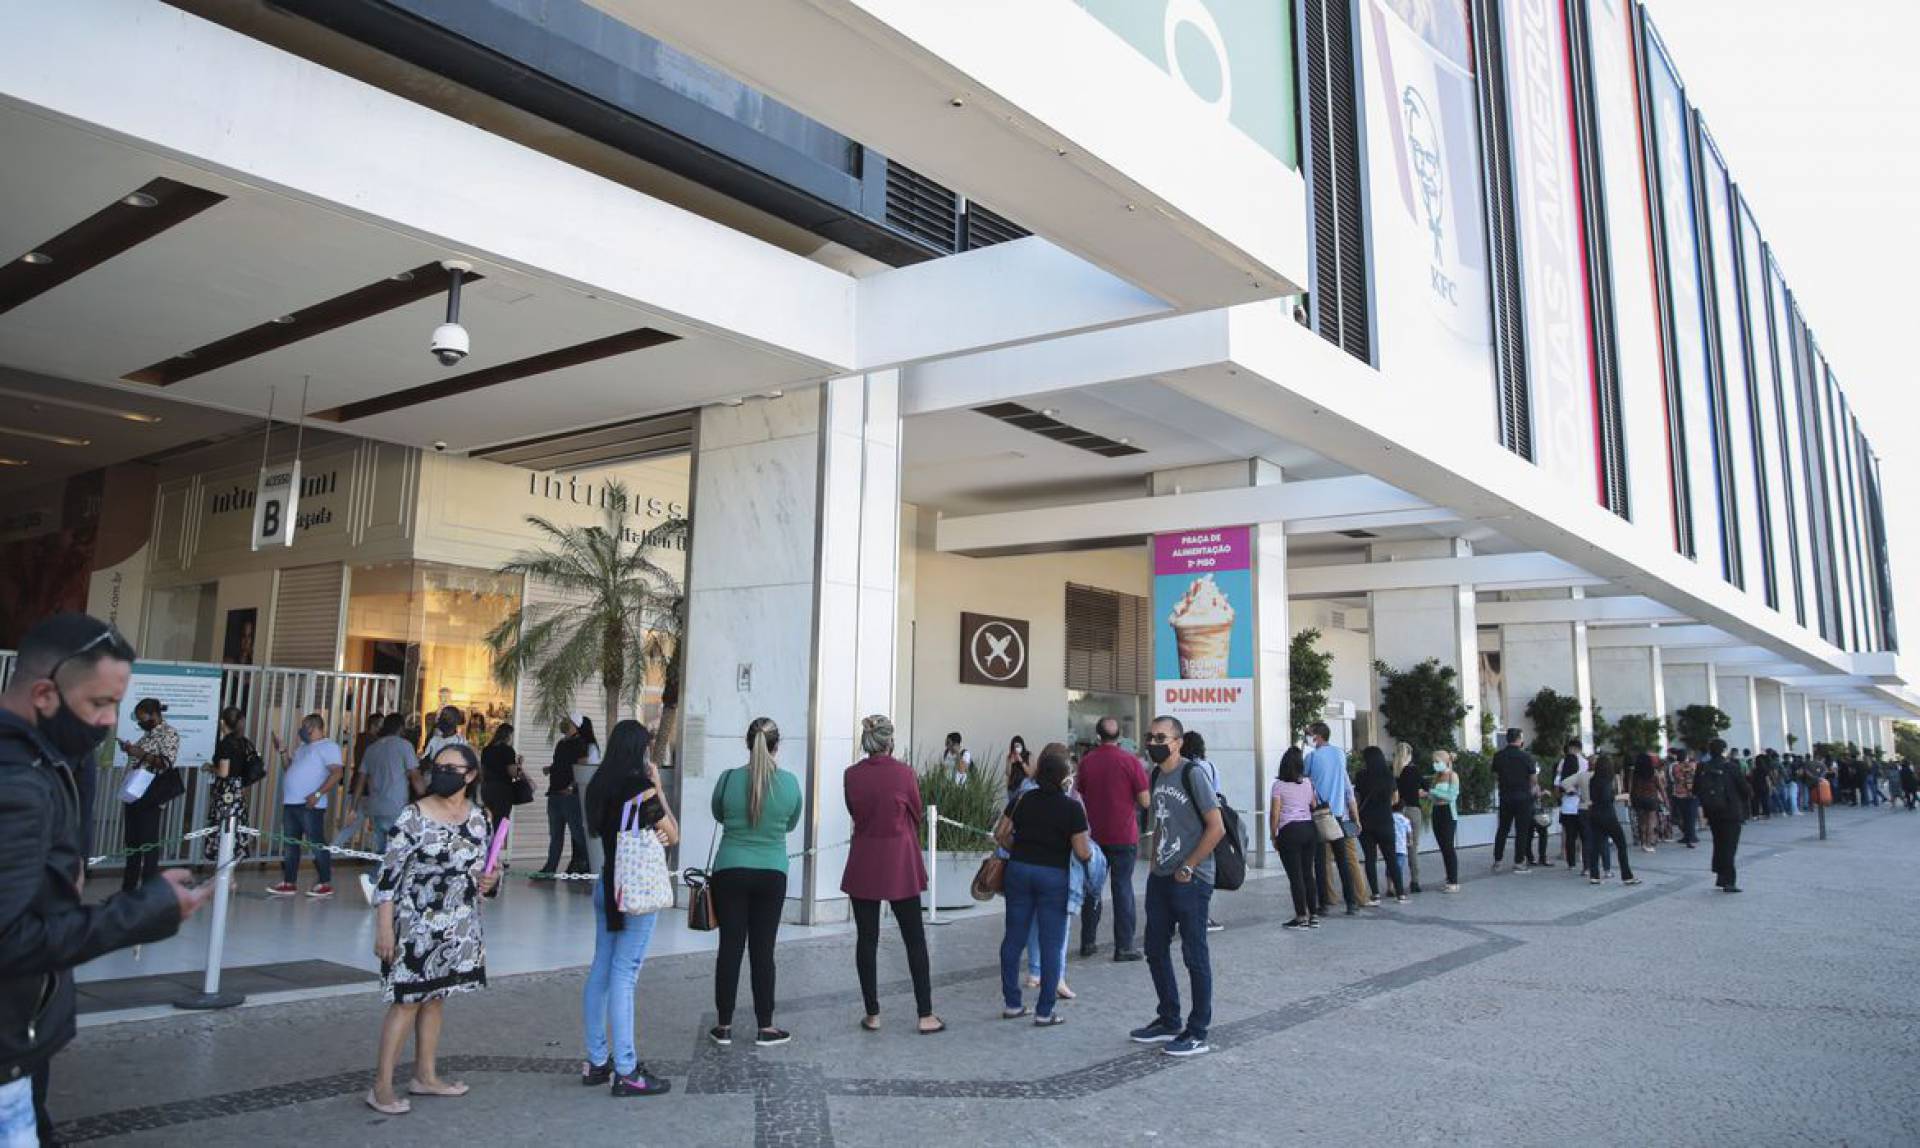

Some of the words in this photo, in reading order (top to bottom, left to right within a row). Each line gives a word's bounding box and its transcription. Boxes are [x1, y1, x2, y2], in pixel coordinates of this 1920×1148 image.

[1430, 264, 1458, 308] KFC
[262, 500, 281, 536] B
[1181, 534, 1210, 545] PRAÇA
[1210, 533, 1222, 542] DE
[1172, 543, 1232, 557] ALIMENTAÇÃO
[1197, 557, 1217, 567] PISO
[1165, 687, 1242, 704] DUNKIN'
